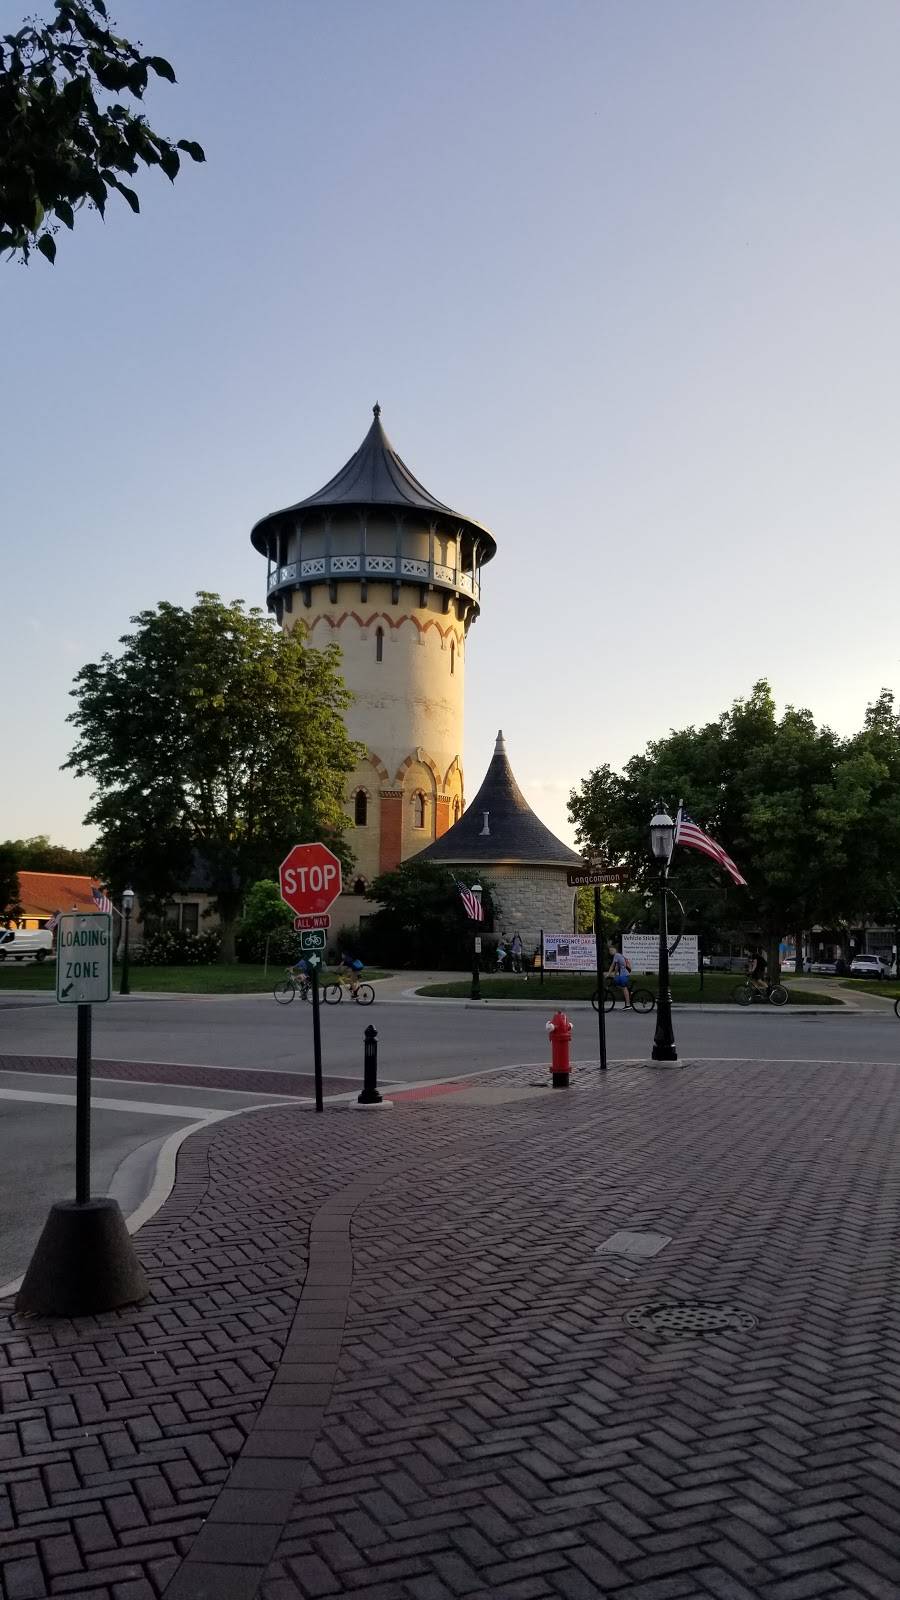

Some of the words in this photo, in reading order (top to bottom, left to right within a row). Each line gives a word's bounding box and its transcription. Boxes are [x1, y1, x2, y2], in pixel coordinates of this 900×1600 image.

[285, 864, 336, 895] STOP
[570, 874, 620, 885] Longcommon
[297, 919, 311, 929] ALL
[313, 917, 328, 927] WAY
[61, 930, 107, 947] LOADING
[66, 961, 99, 978] ZONE
